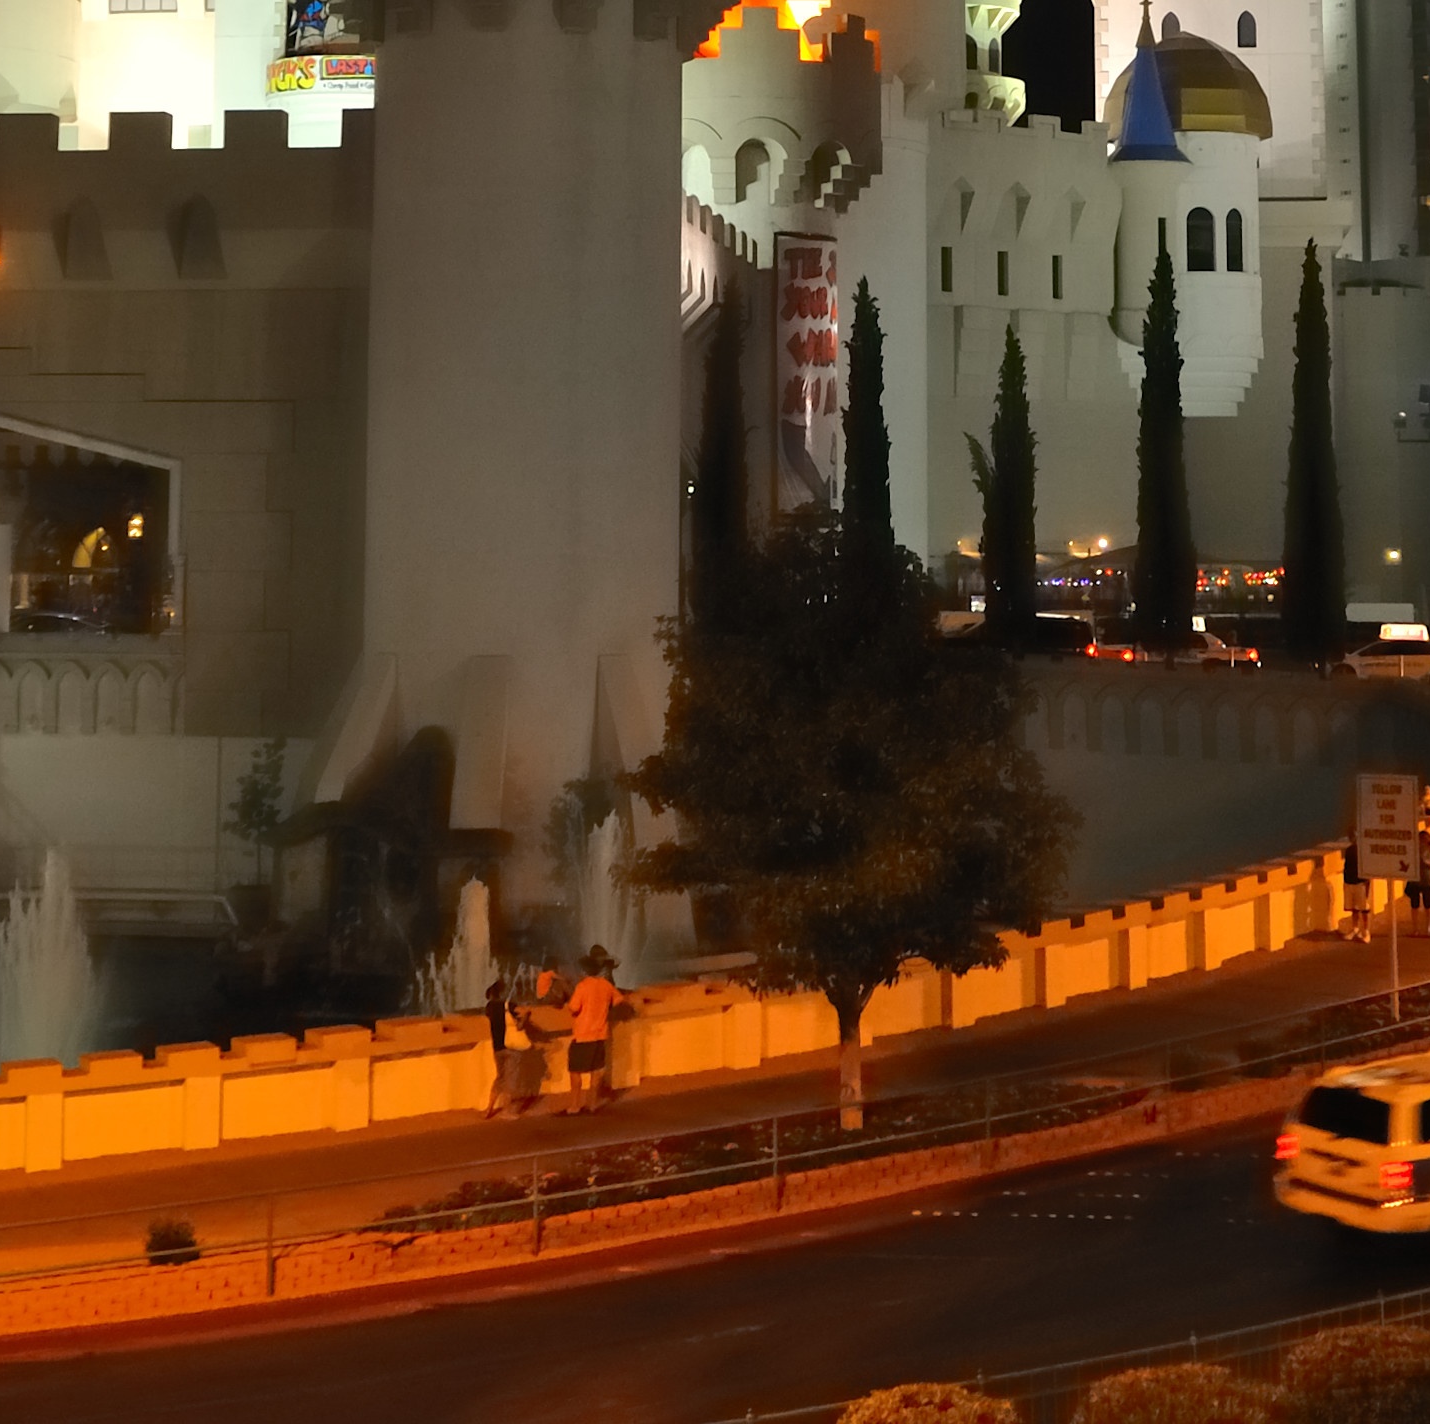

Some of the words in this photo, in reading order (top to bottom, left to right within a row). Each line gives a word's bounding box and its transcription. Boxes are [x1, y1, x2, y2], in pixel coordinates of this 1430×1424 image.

[325, 58, 368, 76] LAST
[1372, 783, 1403, 795] YELLOW
[1376, 799, 1397, 810] LANE
[1379, 814, 1395, 825] FOR
[1364, 829, 1413, 841] AUTHORIZED
[1370, 844, 1407, 855] VEHICLES
